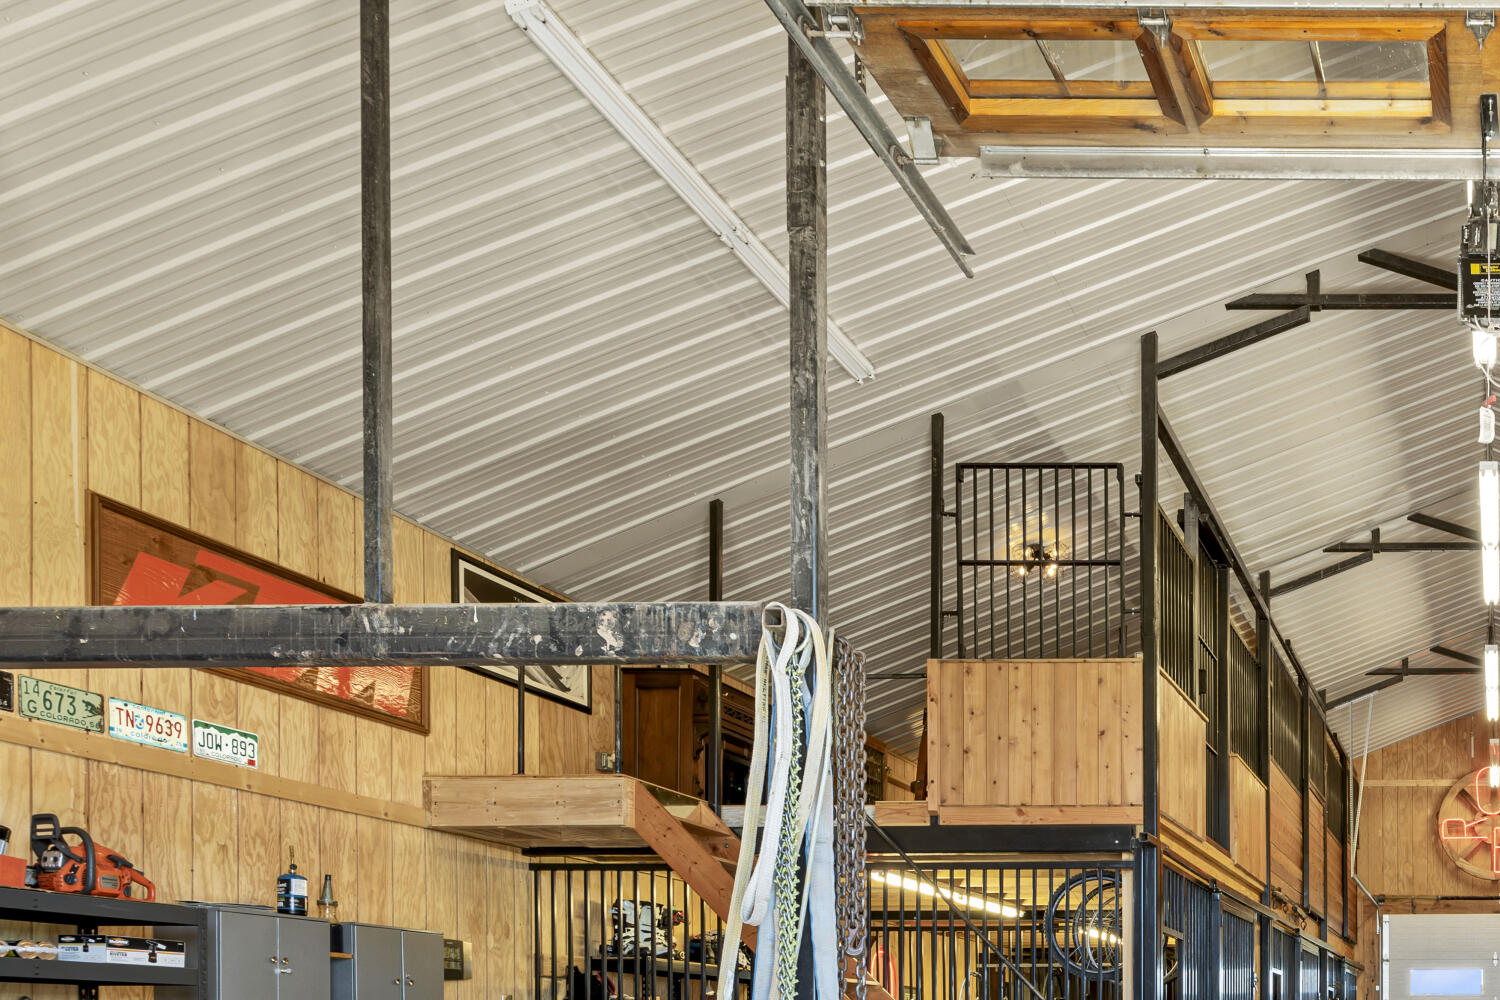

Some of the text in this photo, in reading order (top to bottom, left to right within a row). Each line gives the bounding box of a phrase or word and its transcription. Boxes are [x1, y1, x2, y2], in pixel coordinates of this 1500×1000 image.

[23, 680, 40, 696] 14
[27, 699, 38, 713] G
[43, 690, 77, 716] 673
[40, 710, 87, 726] COLORADO
